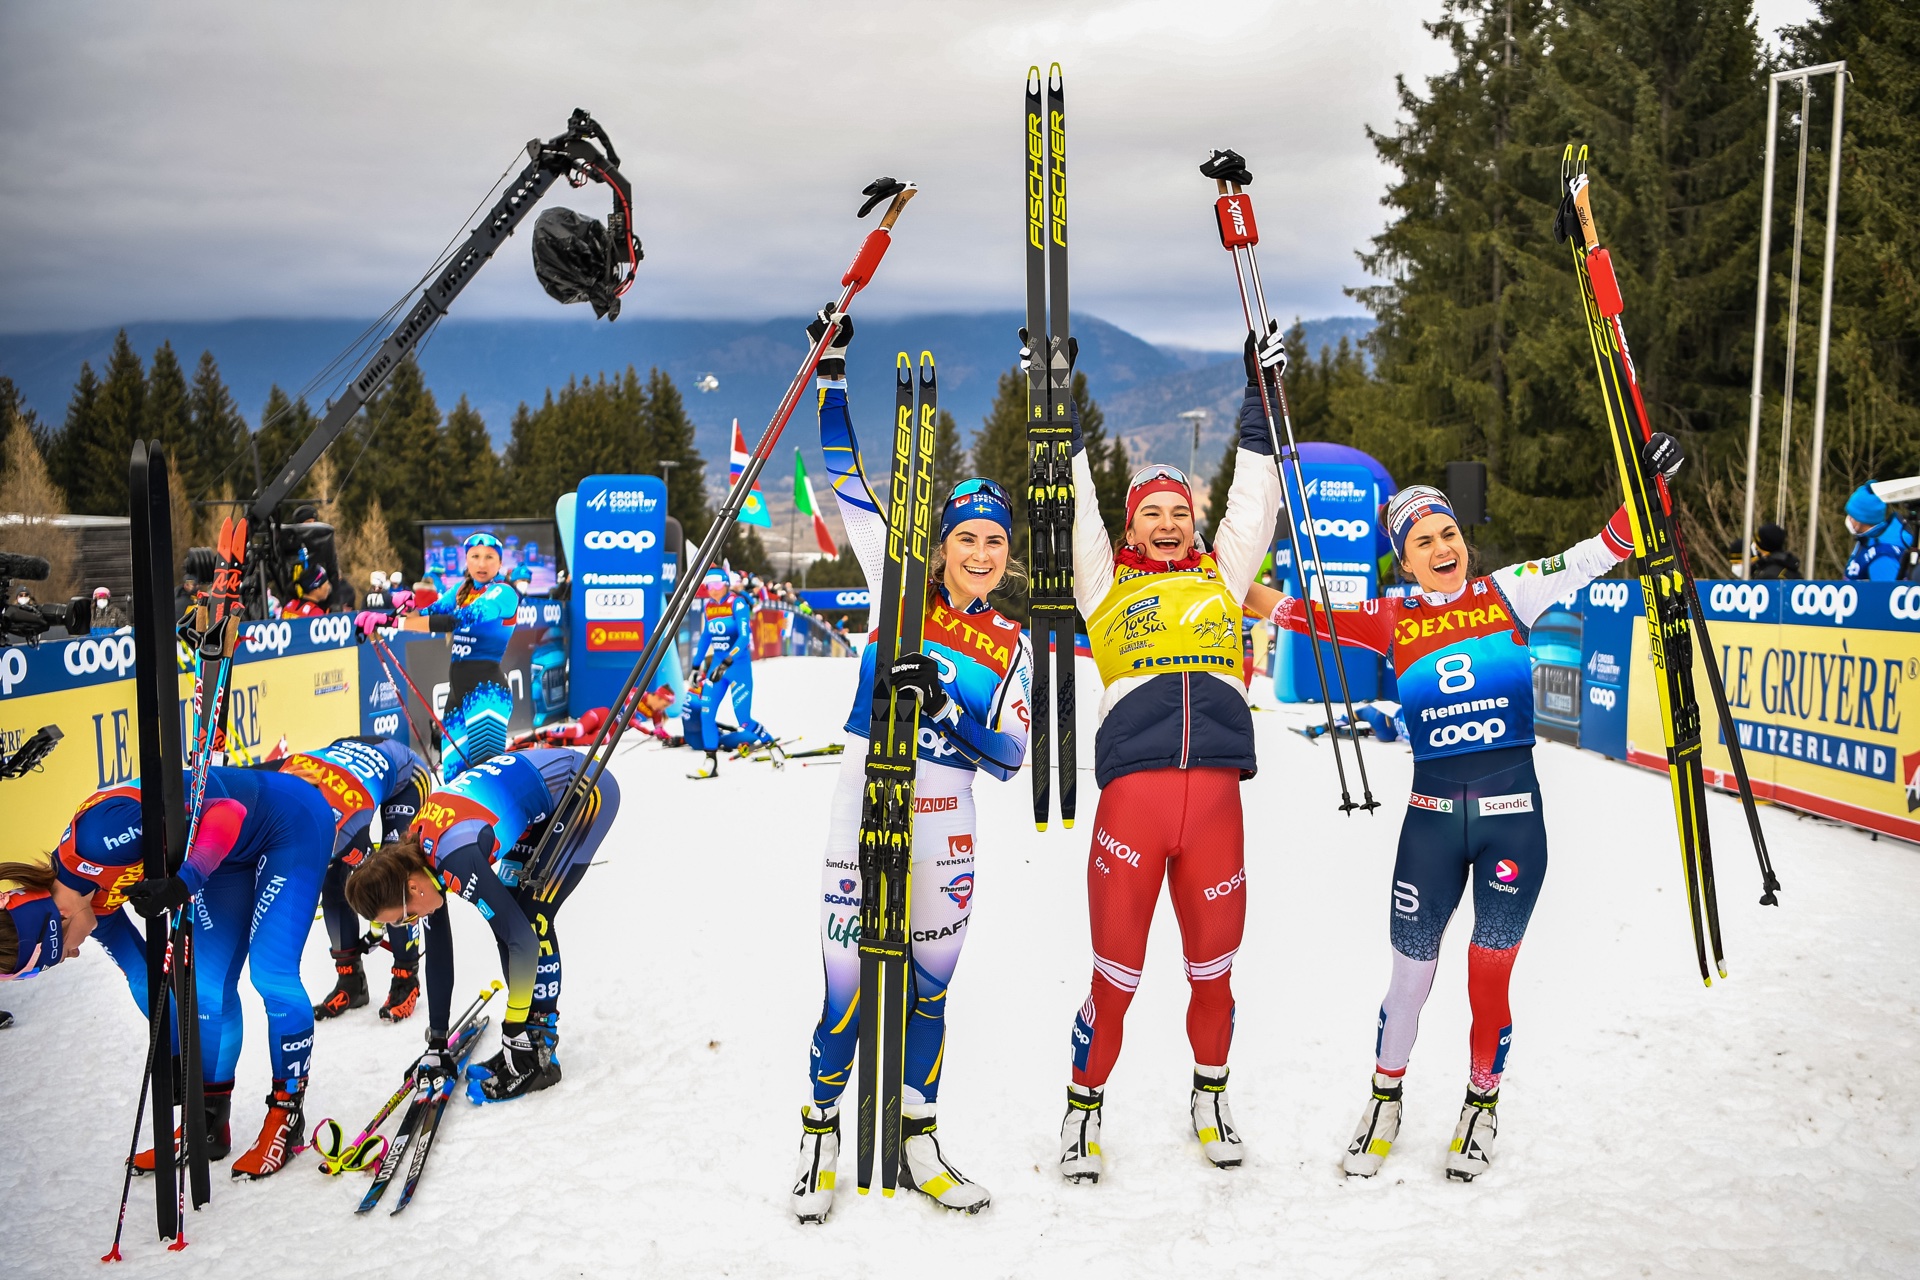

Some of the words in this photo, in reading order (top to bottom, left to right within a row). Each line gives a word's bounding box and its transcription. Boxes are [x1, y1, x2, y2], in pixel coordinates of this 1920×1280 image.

[1029, 112, 1043, 250] FISCHER
[1051, 110, 1066, 247] FISCHER
[1228, 198, 1247, 237] swix
[1577, 205, 1588, 227] swix
[1576, 246, 1608, 357] FISCH
[889, 404, 912, 564] FISCHER
[912, 403, 935, 563] FISCHER
[1320, 481, 1354, 489] CROSS
[1320, 489, 1366, 497] COUNTRY
[609, 491, 644, 499] CROSS
[609, 499, 657, 507] COUNTRY
[1300, 518, 1369, 541] coop
[584, 530, 656, 553] coop
[1649, 554, 1675, 568] FISCHER
[583, 573, 654, 585] fiemme
[367, 593, 384, 607] ITA
[836, 592, 870, 604] coo
[1130, 598, 1155, 611] coop
[1590, 582, 1628, 613] coop
[1710, 583, 1769, 620] coop
[1791, 584, 1858, 624] coop
[310, 615, 351, 646] coop
[708, 621, 726, 635] 40
[1421, 604, 1509, 638] EXTRA
[1639, 574, 1664, 670] FISCHER
[246, 621, 291, 656] coop
[608, 631, 639, 641] EXTRA
[931, 605, 1009, 670] EXTRA
[64, 635, 136, 677] coop
[1132, 655, 1235, 669] fiemme
[1597, 653, 1615, 664] CROSS
[1435, 653, 1476, 694] 8
[1017, 665, 1032, 707] Folksa
[1722, 645, 1752, 709] LE
[1761, 638, 1904, 735] GRUYÈRE
[1421, 696, 1509, 722] fiemme
[1590, 687, 1616, 711] coop
[374, 714, 398, 734] coop
[1429, 718, 1506, 748] coop
[92, 708, 132, 790] LE
[1739, 723, 1887, 775] WITZERLAND
[867, 763, 911, 772] FISCHER
[1485, 798, 1528, 811] Scandic
[103, 826, 142, 851] helv
[512, 844, 537, 854] RTH
[1096, 826, 1142, 868] LUKOIL
[936, 858, 970, 866] SVENSKA
[1488, 880, 1519, 895] viaplay
[913, 913, 970, 942] CRAFT
[860, 946, 903, 957] FISCHER
[537, 962, 559, 974] oop
[533, 981, 559, 999] 38
[1069, 1099, 1100, 1110] FISCHER
